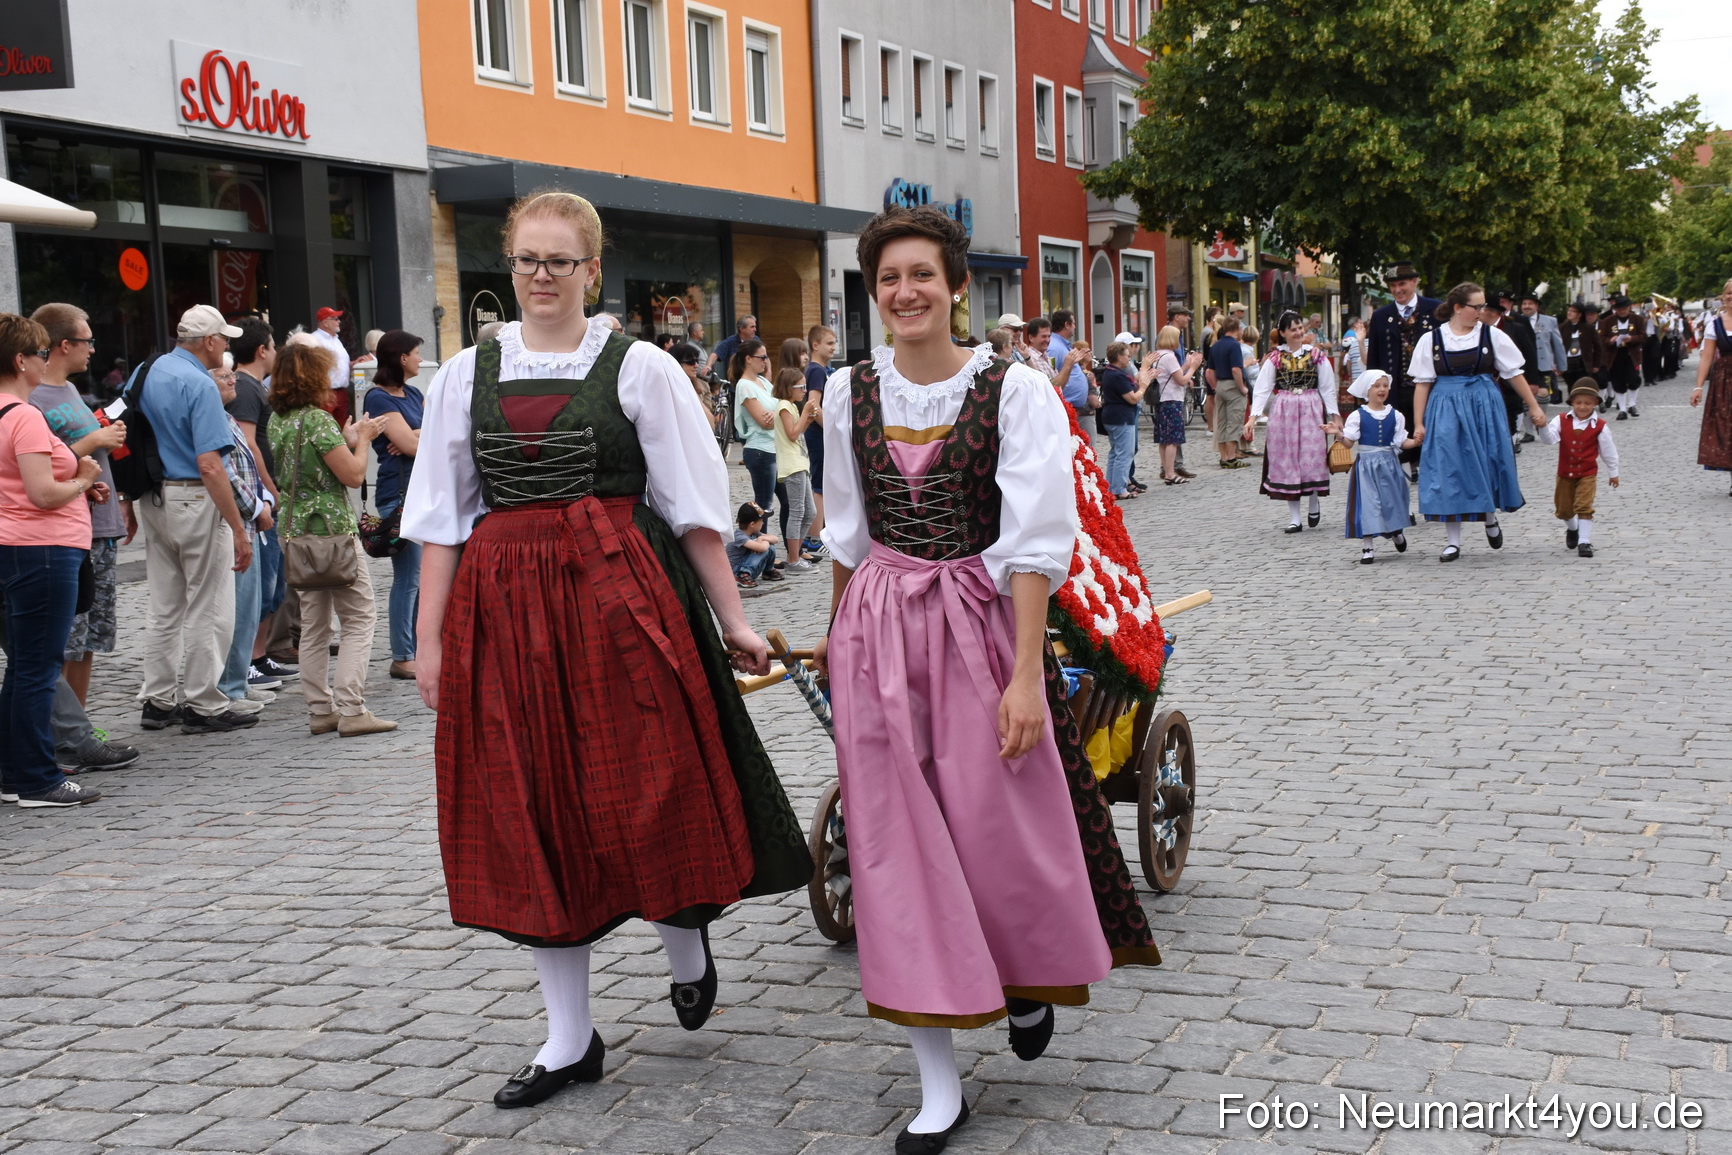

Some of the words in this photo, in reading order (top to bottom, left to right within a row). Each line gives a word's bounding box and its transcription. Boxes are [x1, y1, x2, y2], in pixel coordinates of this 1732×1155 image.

[180, 49, 311, 140] s.Oliver
[125, 258, 144, 276] SALE
[476, 308, 498, 322] Dianas
[667, 312, 684, 324] Dianas
